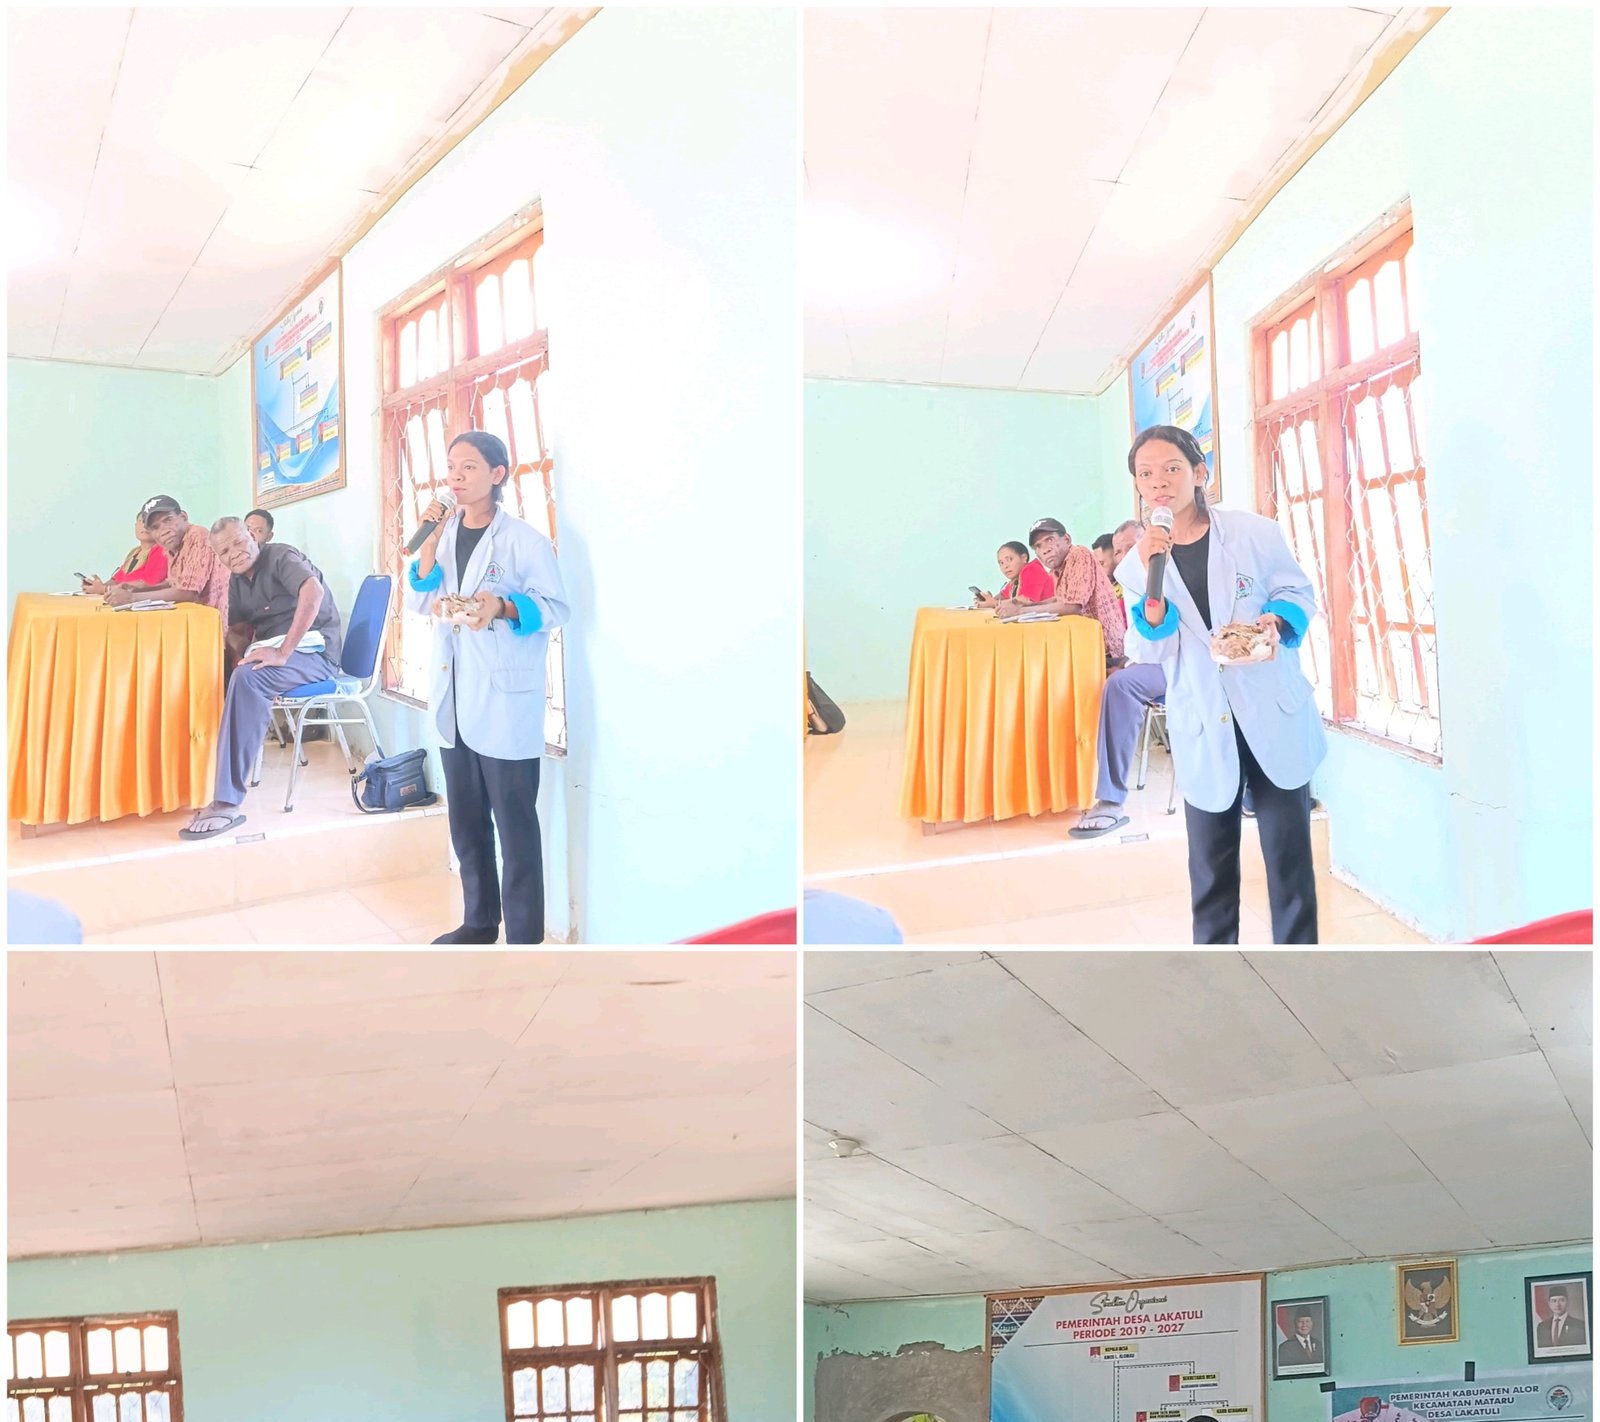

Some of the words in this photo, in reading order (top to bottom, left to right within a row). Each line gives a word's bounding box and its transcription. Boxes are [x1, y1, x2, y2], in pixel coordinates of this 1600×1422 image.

[1056, 1317, 1120, 1329] PEMERINTAH
[1124, 1314, 1150, 1324] DESA
[1154, 1310, 1203, 1322] LAKATULI
[1073, 1329, 1116, 1340] PERIODE
[1120, 1326, 1146, 1336] 2019
[1158, 1323, 1184, 1333] 2027
[1390, 1391, 1450, 1400] PEMERINTAH
[1453, 1388, 1510, 1398] KABUPATEN
[1512, 1386, 1538, 1394] ALOR
[1413, 1400, 1472, 1410] KECAMATAN
[1474, 1398, 1514, 1406] MATARU
[1428, 1410, 1452, 1418] DESA
[1455, 1408, 1500, 1416] LAKATULI
